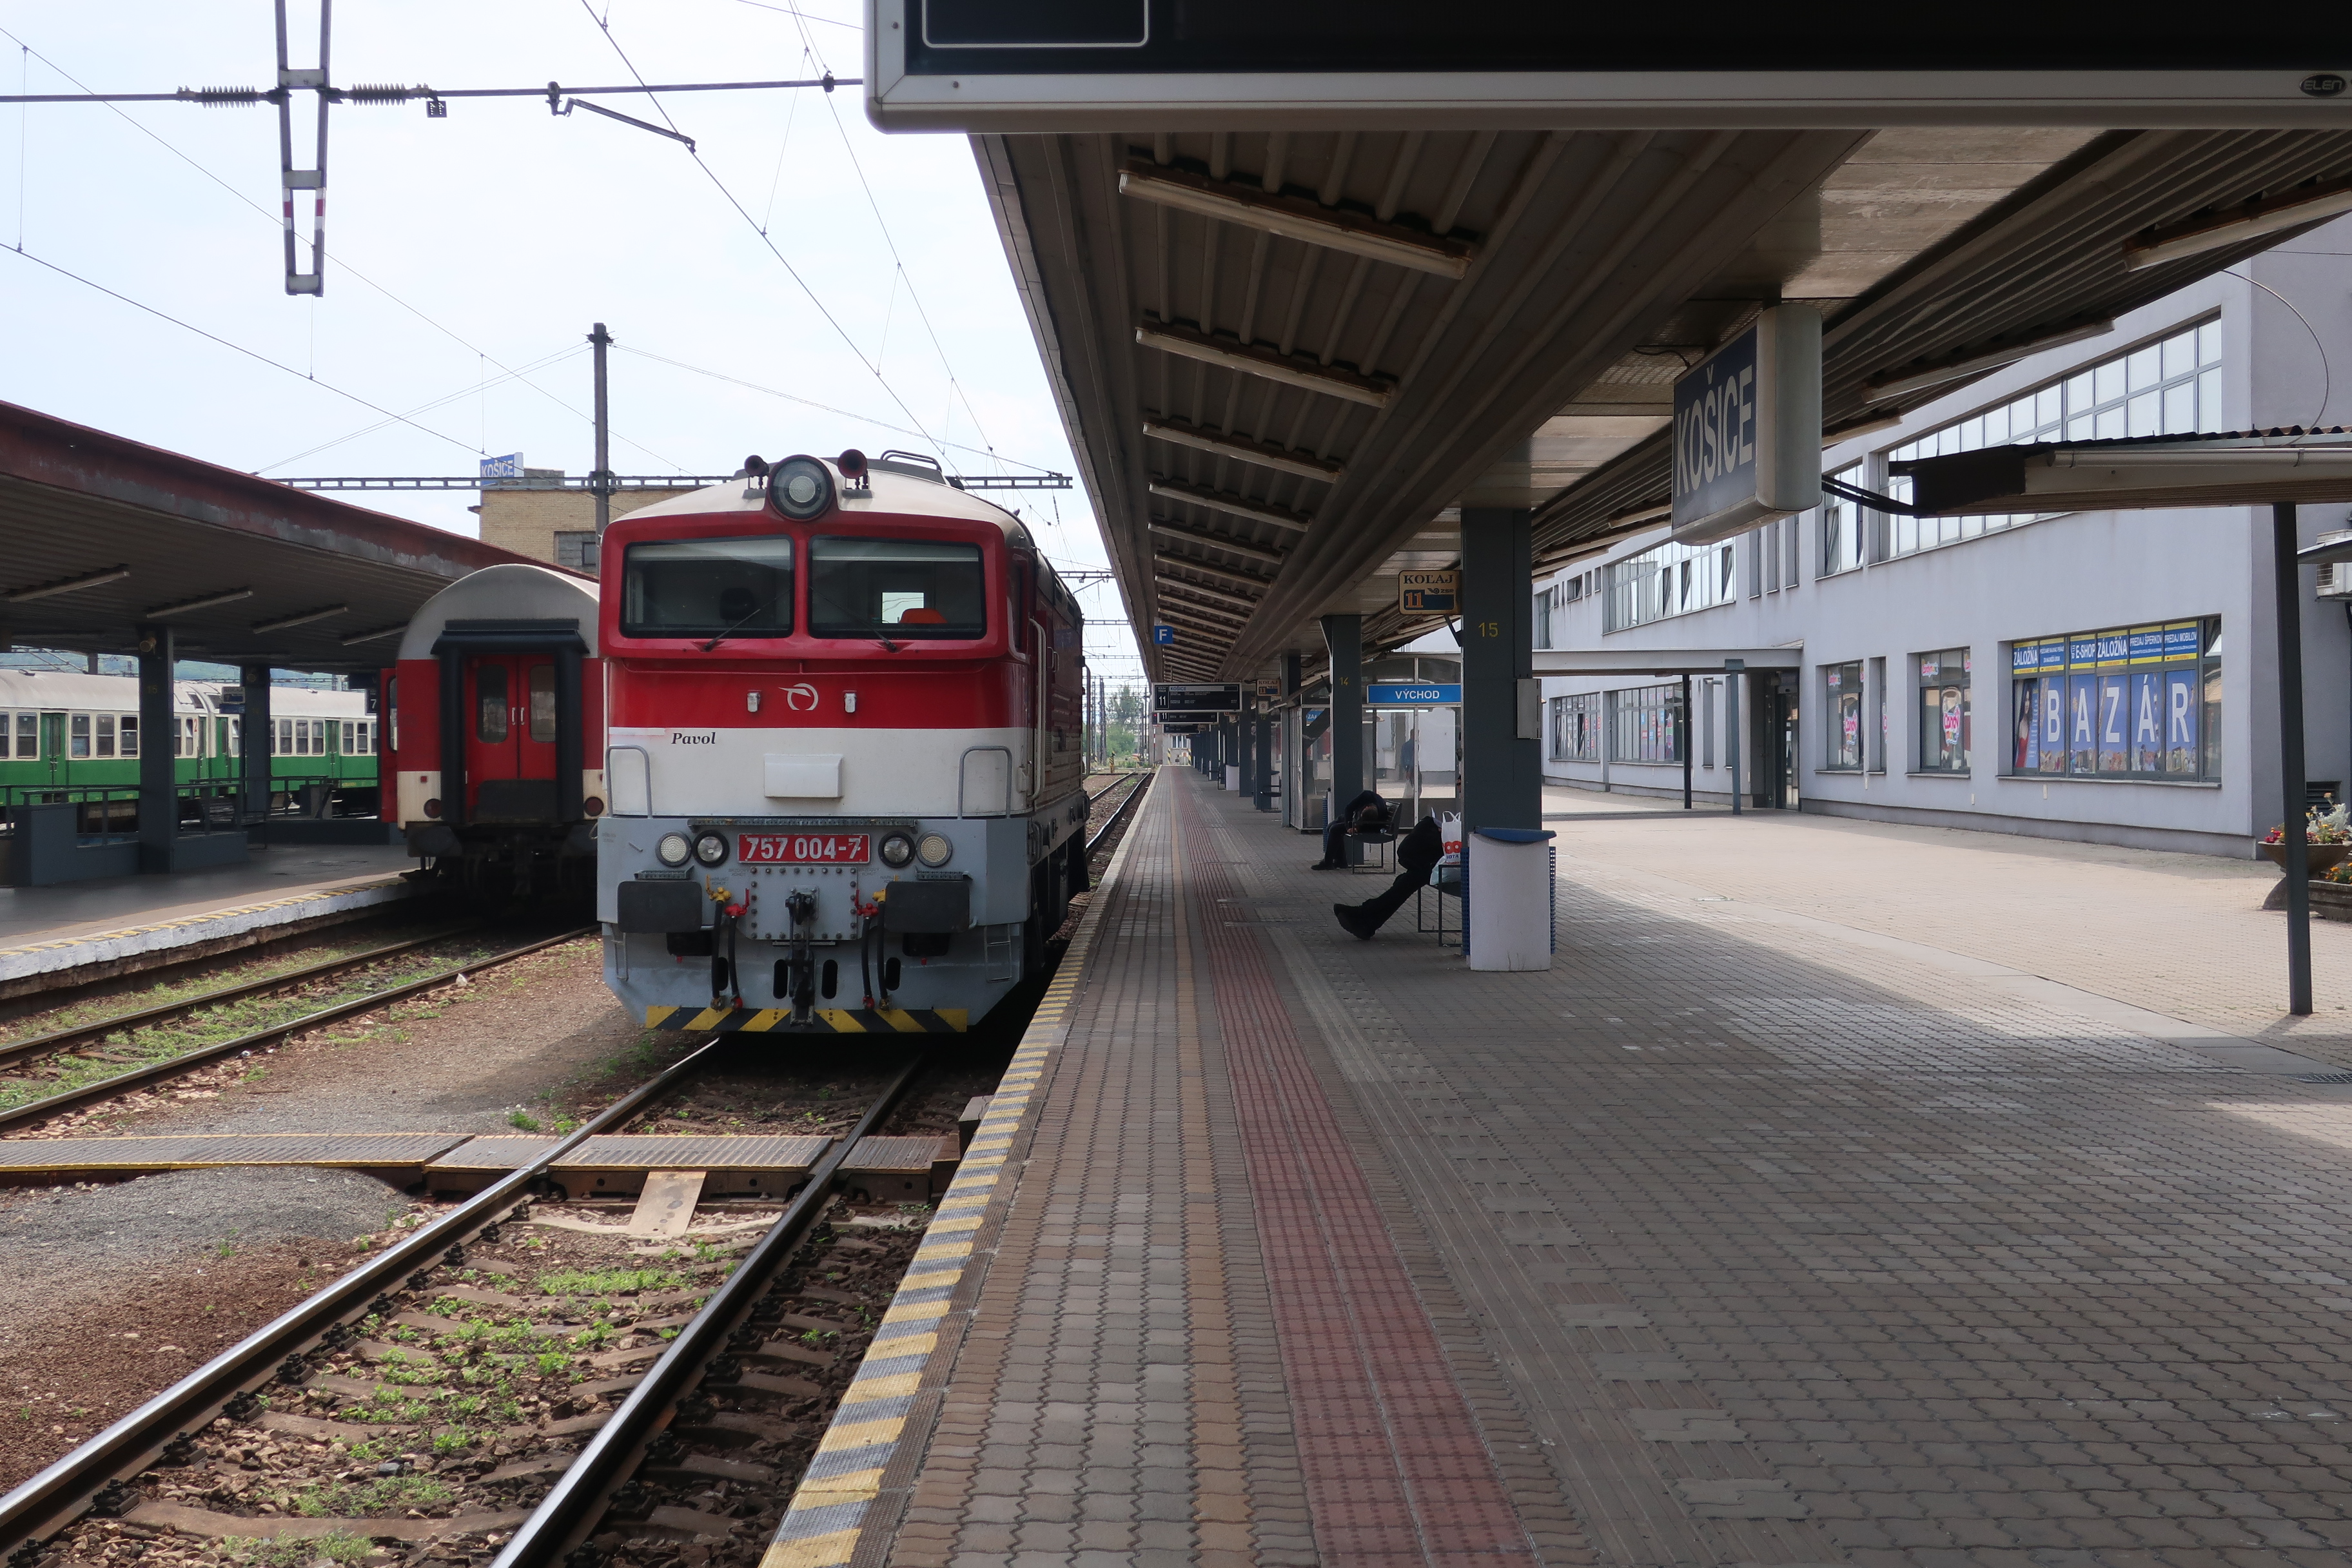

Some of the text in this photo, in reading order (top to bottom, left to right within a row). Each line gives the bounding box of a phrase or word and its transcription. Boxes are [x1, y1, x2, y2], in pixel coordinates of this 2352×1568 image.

[1676, 362, 1752, 497] KOŠICE
[481, 459, 514, 477] KOŠICE
[1403, 574, 1454, 584] KOĽAJ
[1406, 592, 1424, 608] 11
[1159, 629, 1168, 642] F
[1478, 622, 1499, 638] 15
[2097, 636, 2128, 658] ZÁLOŽŇA
[2014, 646, 2038, 666] ZÁLOŽŇA
[1339, 677, 1349, 686] 14
[1159, 696, 1166, 706] 11
[1395, 689, 1440, 700] VÝCHOD
[370, 699, 377, 709] 7
[2048, 674, 2190, 743] BAZÁR
[194, 718, 197, 732] 2
[671, 731, 716, 745] Pavol
[746, 838, 861, 859] 757 004-7
